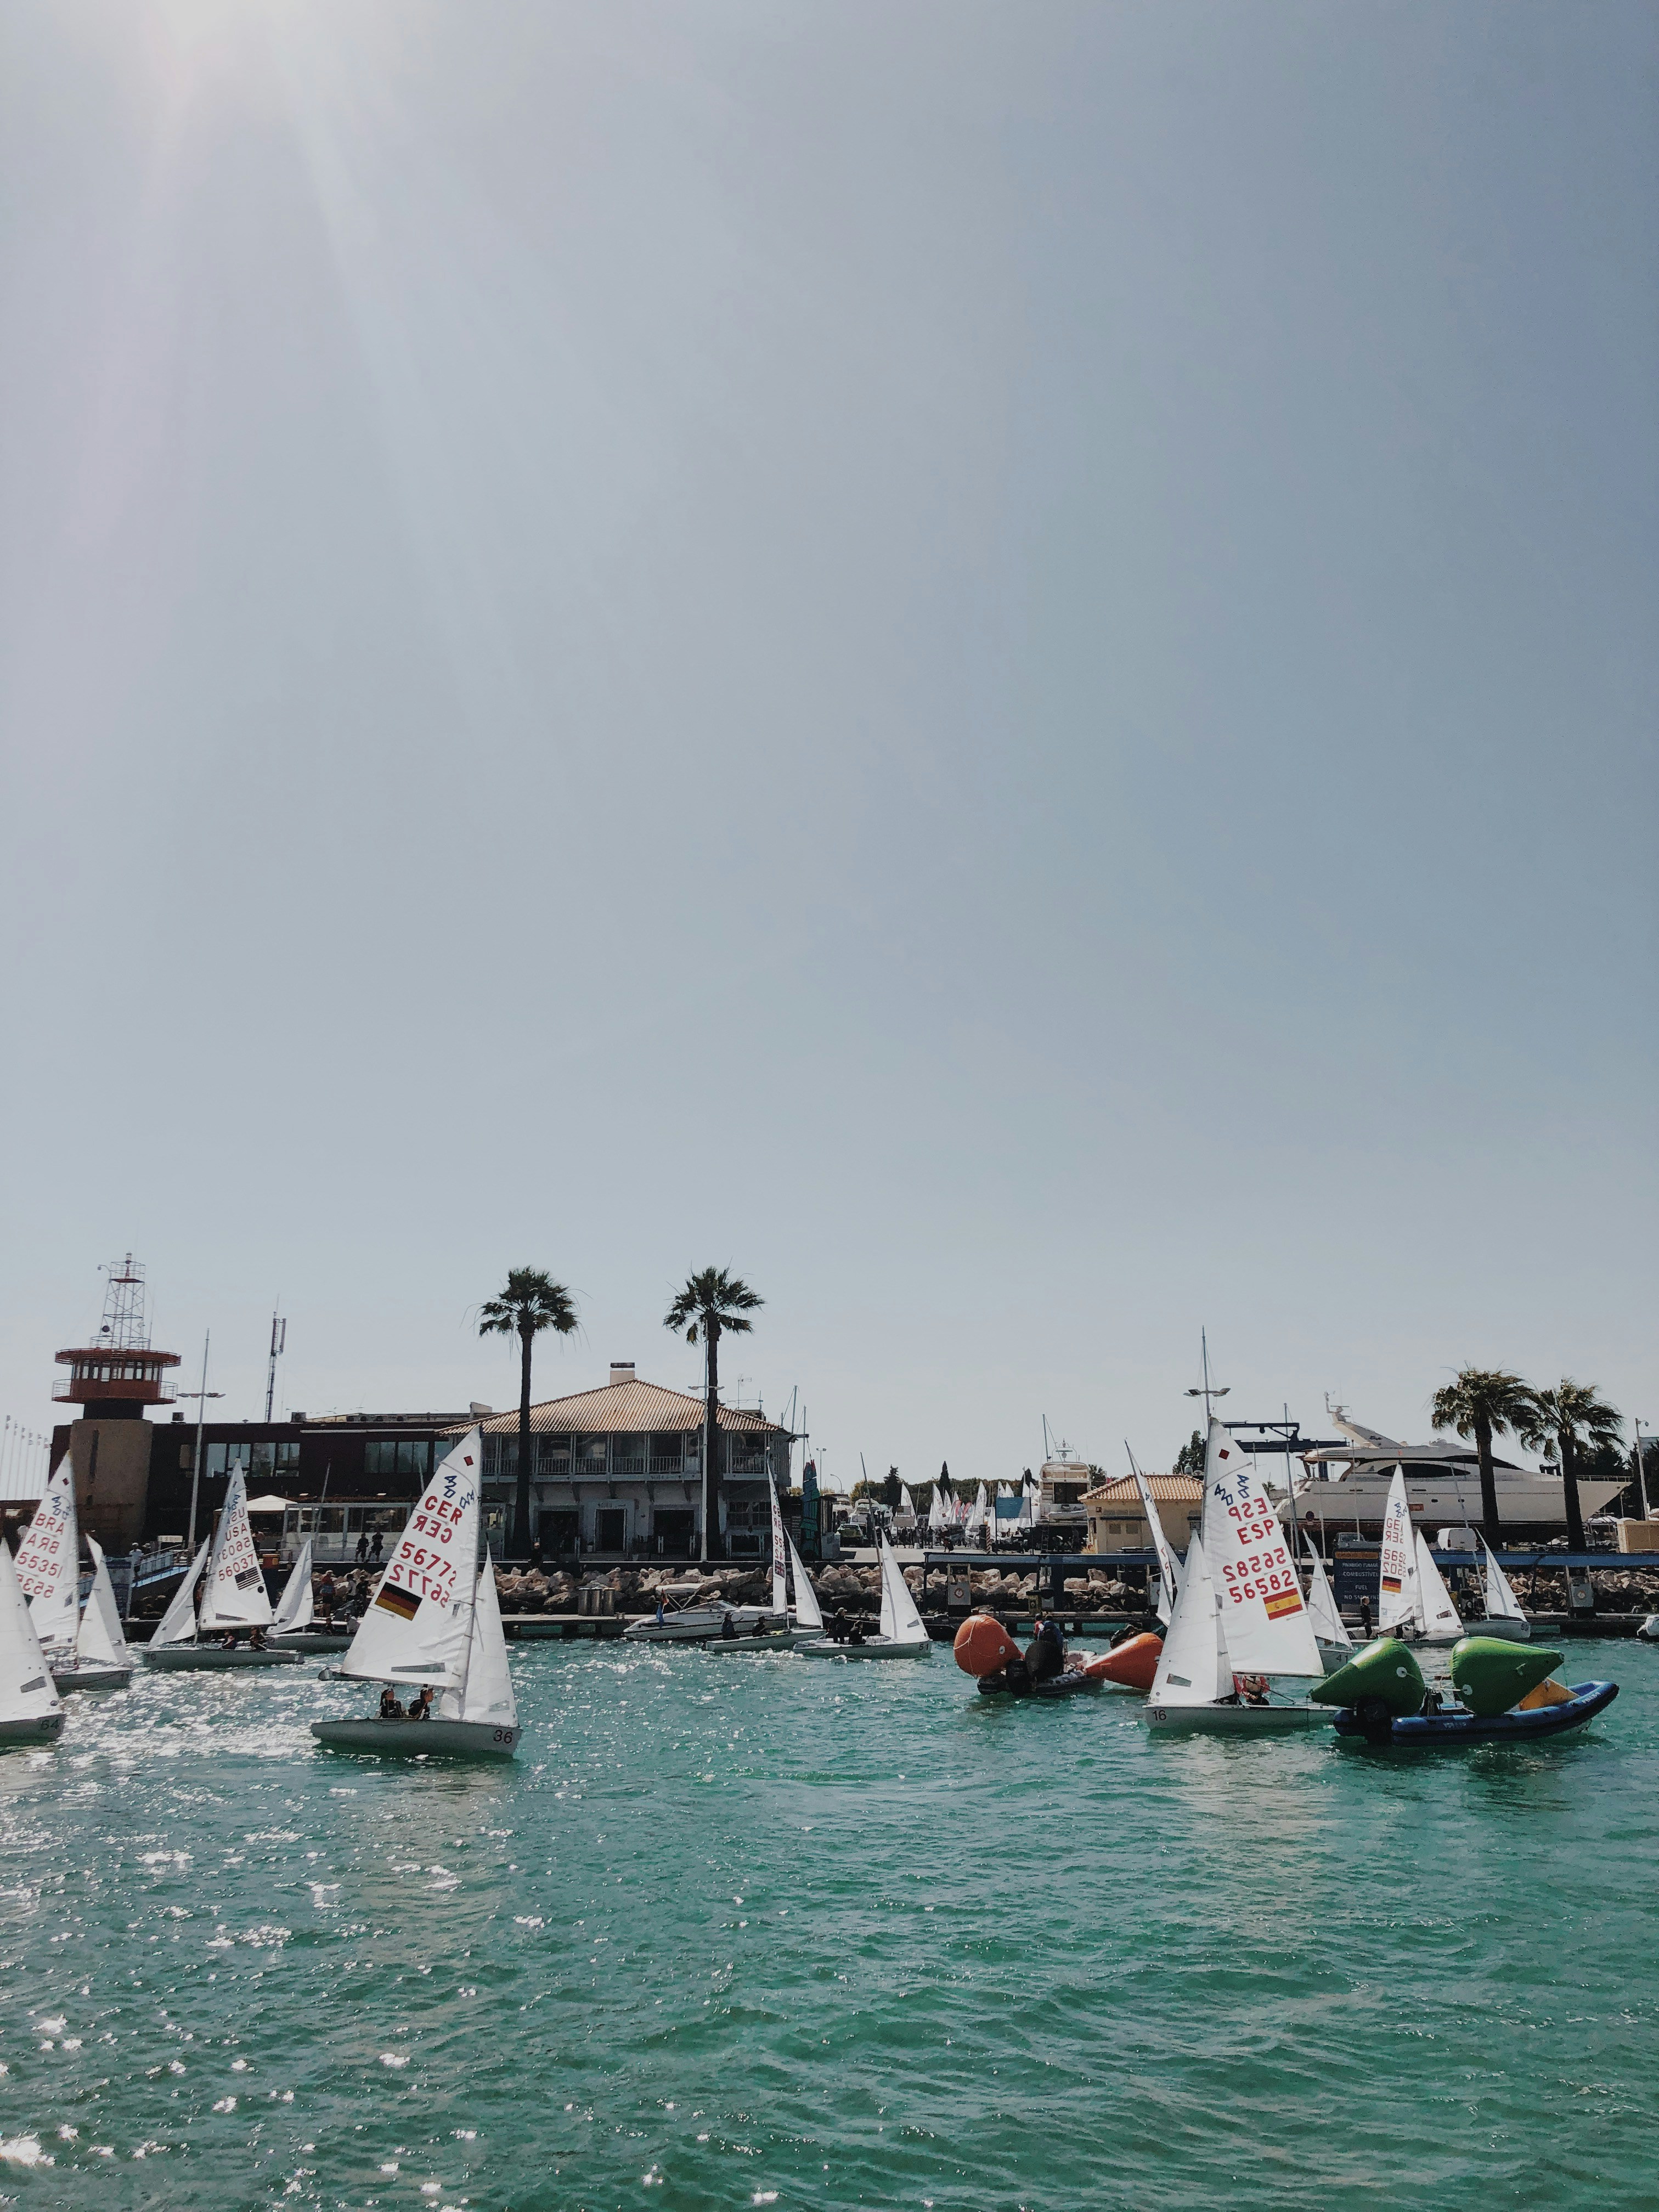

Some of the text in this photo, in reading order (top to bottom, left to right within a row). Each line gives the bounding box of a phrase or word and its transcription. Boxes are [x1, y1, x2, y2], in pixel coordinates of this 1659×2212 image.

[1214, 1483, 1233, 1506] 420
[425, 1496, 462, 1525] GER
[35, 1513, 65, 1535] BRA
[225, 1523, 248, 1541] USA
[1237, 1519, 1274, 1545] ESP
[1386, 1517, 1403, 1532] GE
[17, 1551, 64, 1579] 55351
[219, 1554, 253, 1581] 56037
[1229, 1570, 1294, 1603] 56582
[41, 1719, 59, 1730] 64
[1153, 1709, 1167, 1721] 16
[493, 1729, 513, 1743] 36
